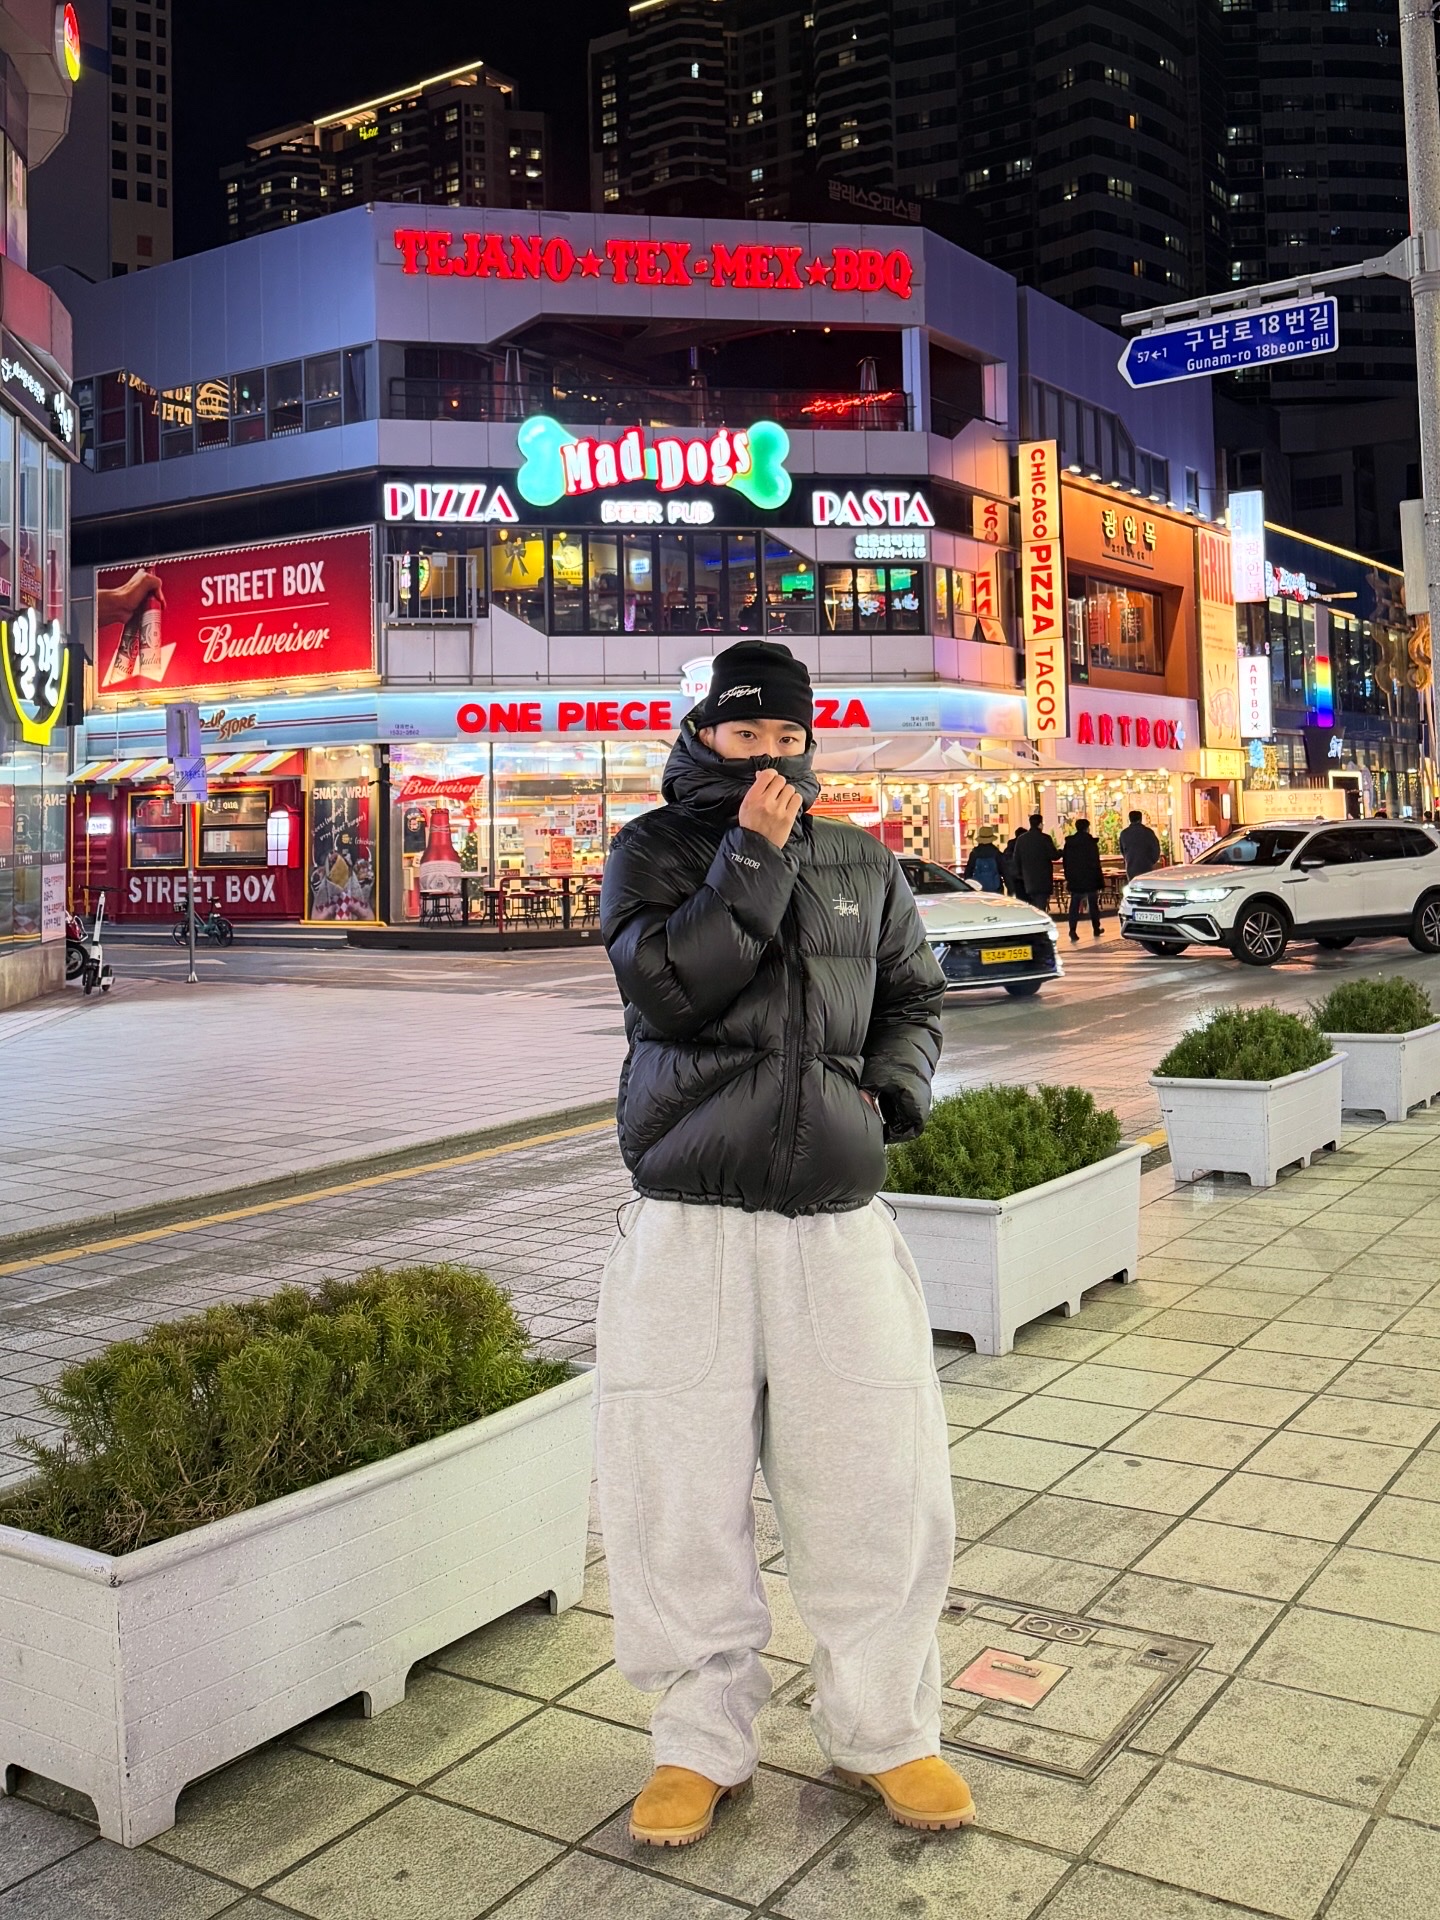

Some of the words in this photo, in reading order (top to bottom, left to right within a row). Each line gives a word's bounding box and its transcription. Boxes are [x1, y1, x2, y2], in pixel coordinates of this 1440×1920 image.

[828, 180, 921, 222] 팔레스오피스텔
[394, 229, 575, 282] TEJANO
[832, 248, 912, 298] BBQ
[1187, 350, 1251, 371] Gunam-ro
[1255, 333, 1330, 359] 18beon-gil
[563, 430, 643, 495] Mad
[656, 430, 749, 491] Dogs
[384, 483, 519, 522] PIZZA
[602, 501, 663, 524] BEER
[668, 502, 715, 525] PUB
[812, 490, 936, 527] PASTA
[1030, 448, 1047, 539] CHICAGO
[1102, 510, 1157, 551] 광안목
[201, 567, 277, 607] STREET
[283, 560, 326, 598] BOX
[1200, 532, 1235, 607] GRILL
[1030, 545, 1055, 635] PIZZA
[199, 622, 330, 664] Budweiser
[1035, 646, 1056, 731] TACOS
[1250, 664, 1261, 731] ARTBOX
[217, 714, 257, 741] STORE
[456, 702, 543, 733] ONE
[557, 701, 672, 732] PIECE
[1078, 712, 1185, 750] ARTBOX
[313, 786, 344, 800] SNACK
[401, 779, 477, 796] Budweiser
[744, 857, 761, 870] 800
[128, 875, 217, 903] STREET
[226, 874, 277, 903] BOX
